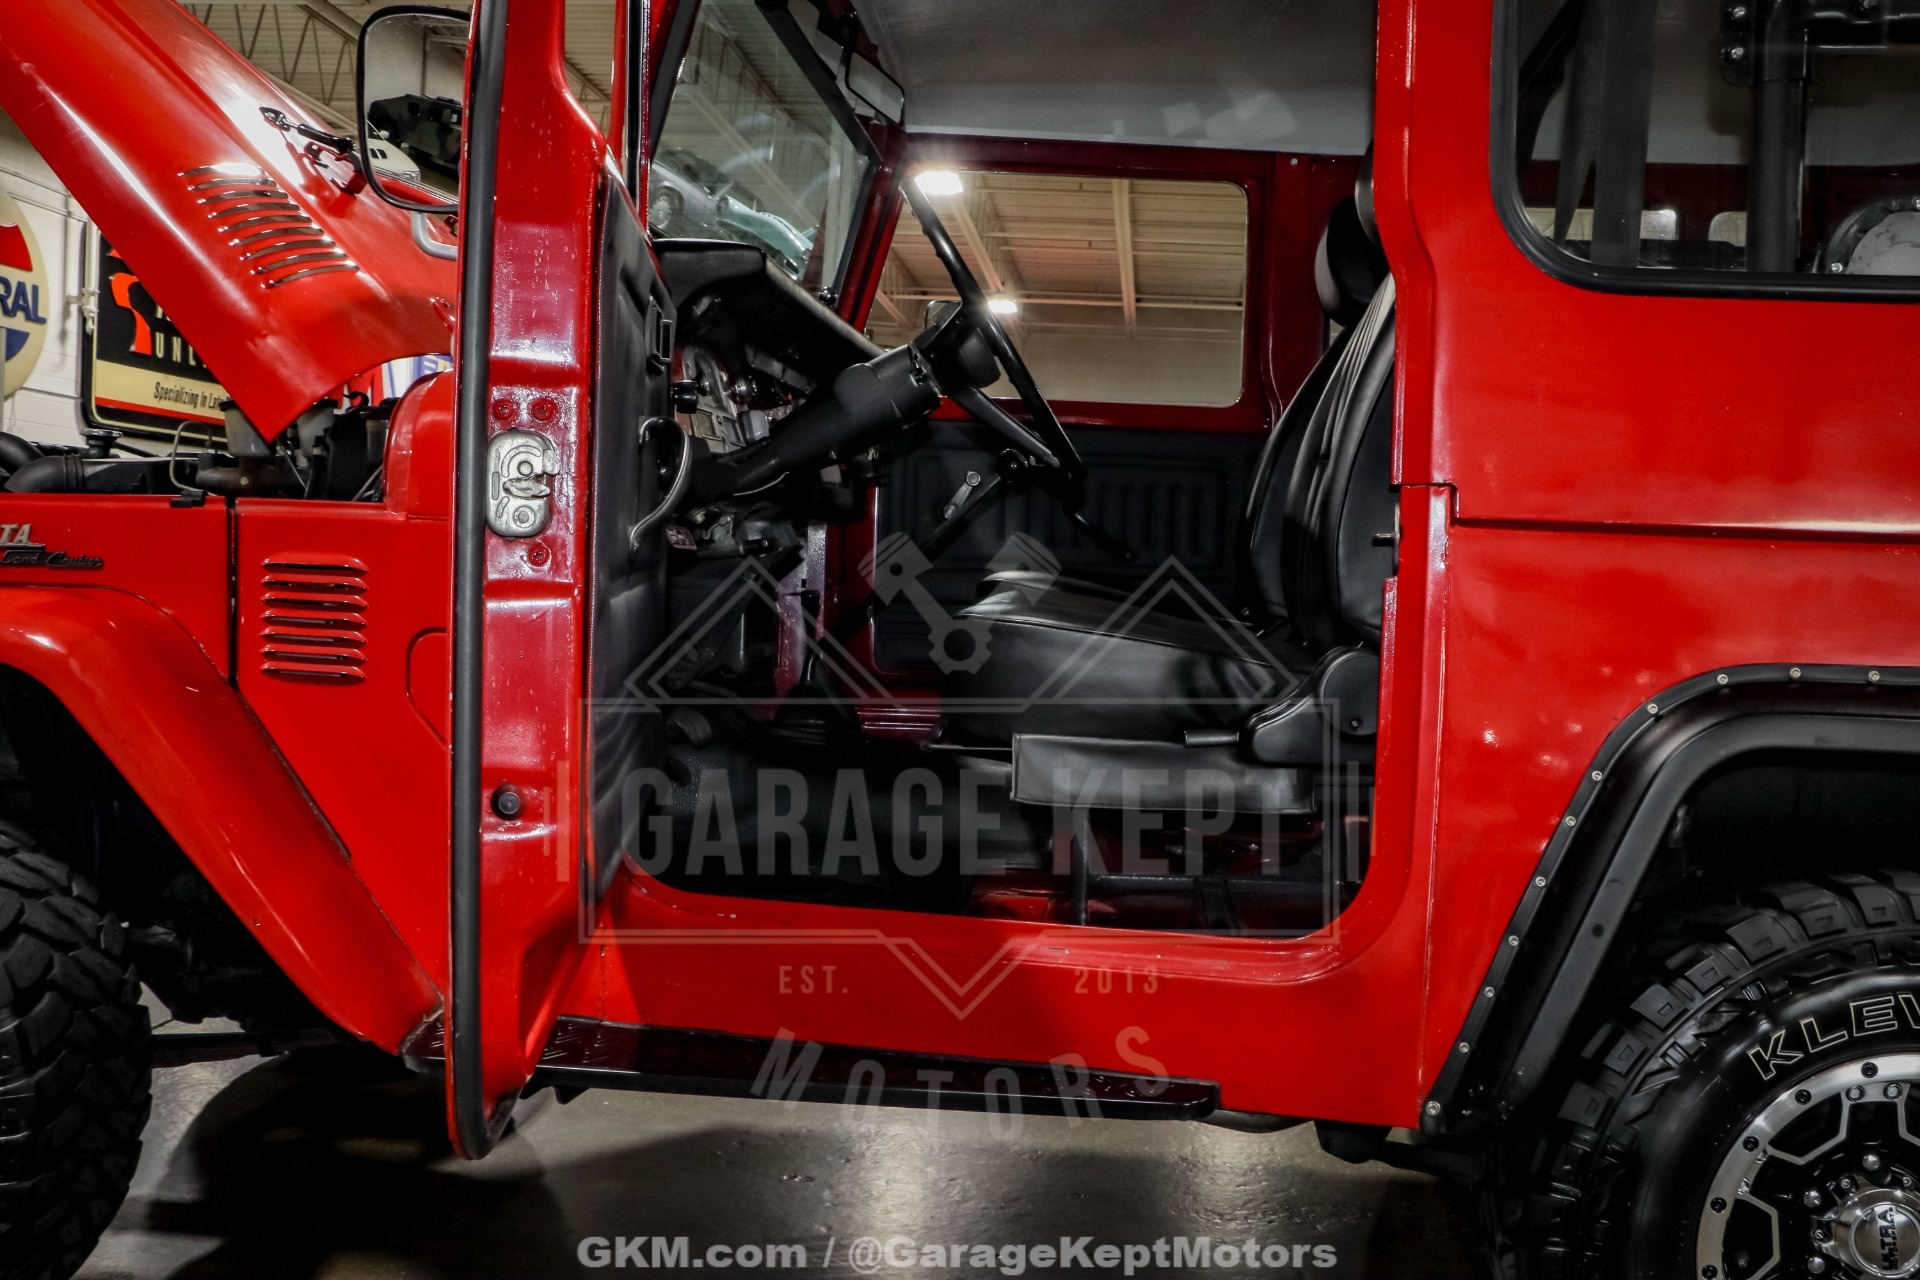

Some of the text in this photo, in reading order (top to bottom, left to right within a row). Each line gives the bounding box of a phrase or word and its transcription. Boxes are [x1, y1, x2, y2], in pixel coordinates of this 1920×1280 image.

[154, 381, 199, 409] Specializing
[46, 551, 103, 568] Cruiser
[1877, 1208, 1893, 1270] ULTRA
